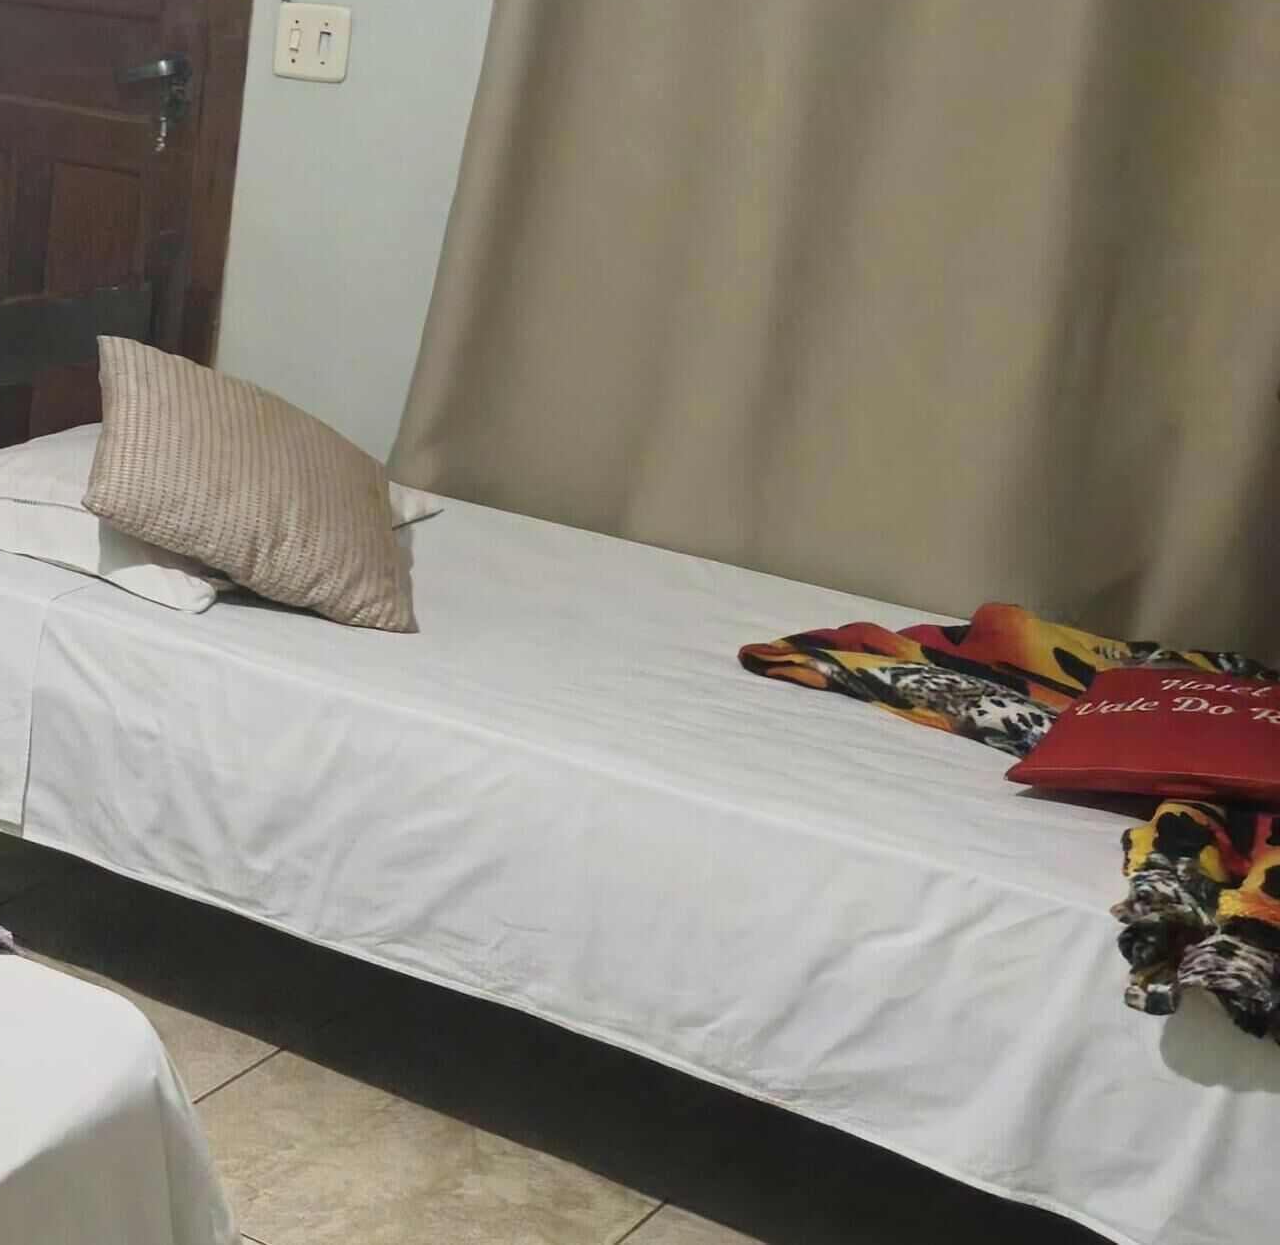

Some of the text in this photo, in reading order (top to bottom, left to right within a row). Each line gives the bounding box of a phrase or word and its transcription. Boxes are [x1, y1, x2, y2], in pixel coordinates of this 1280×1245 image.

[1161, 679, 1272, 698] Hotel
[1075, 697, 1160, 716] Vale
[1171, 696, 1236, 716] Do
